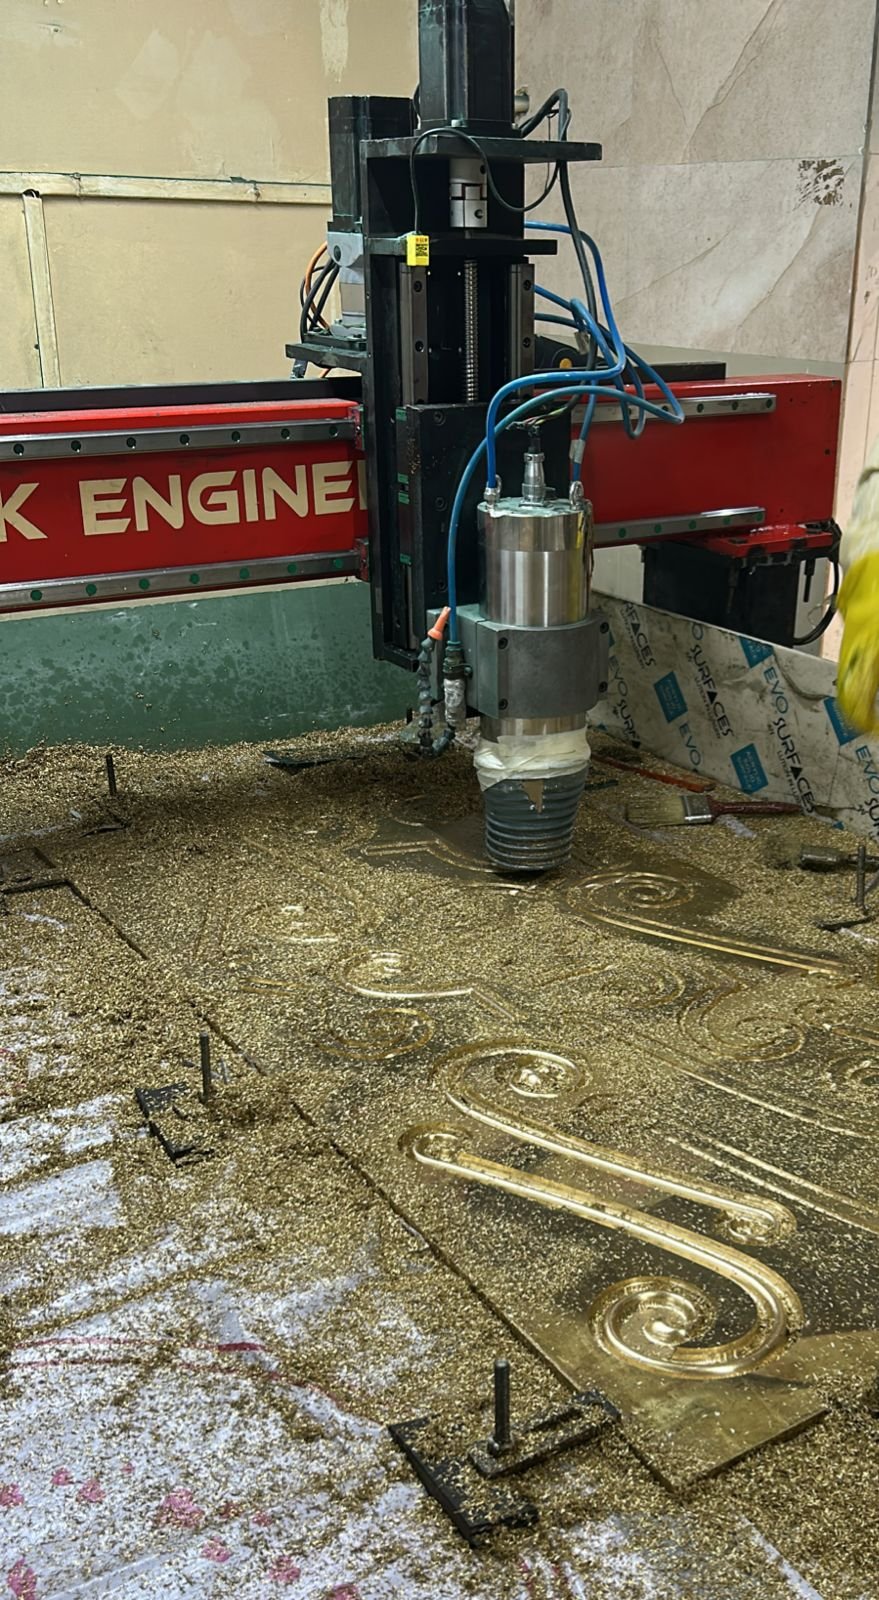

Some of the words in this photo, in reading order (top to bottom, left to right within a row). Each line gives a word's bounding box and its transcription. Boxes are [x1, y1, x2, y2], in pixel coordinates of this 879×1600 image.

[0, 482, 48, 542] K
[78, 460, 368, 536] ENGINE
[763, 666, 789, 714] EVO
[679, 723, 701, 766] EVO
